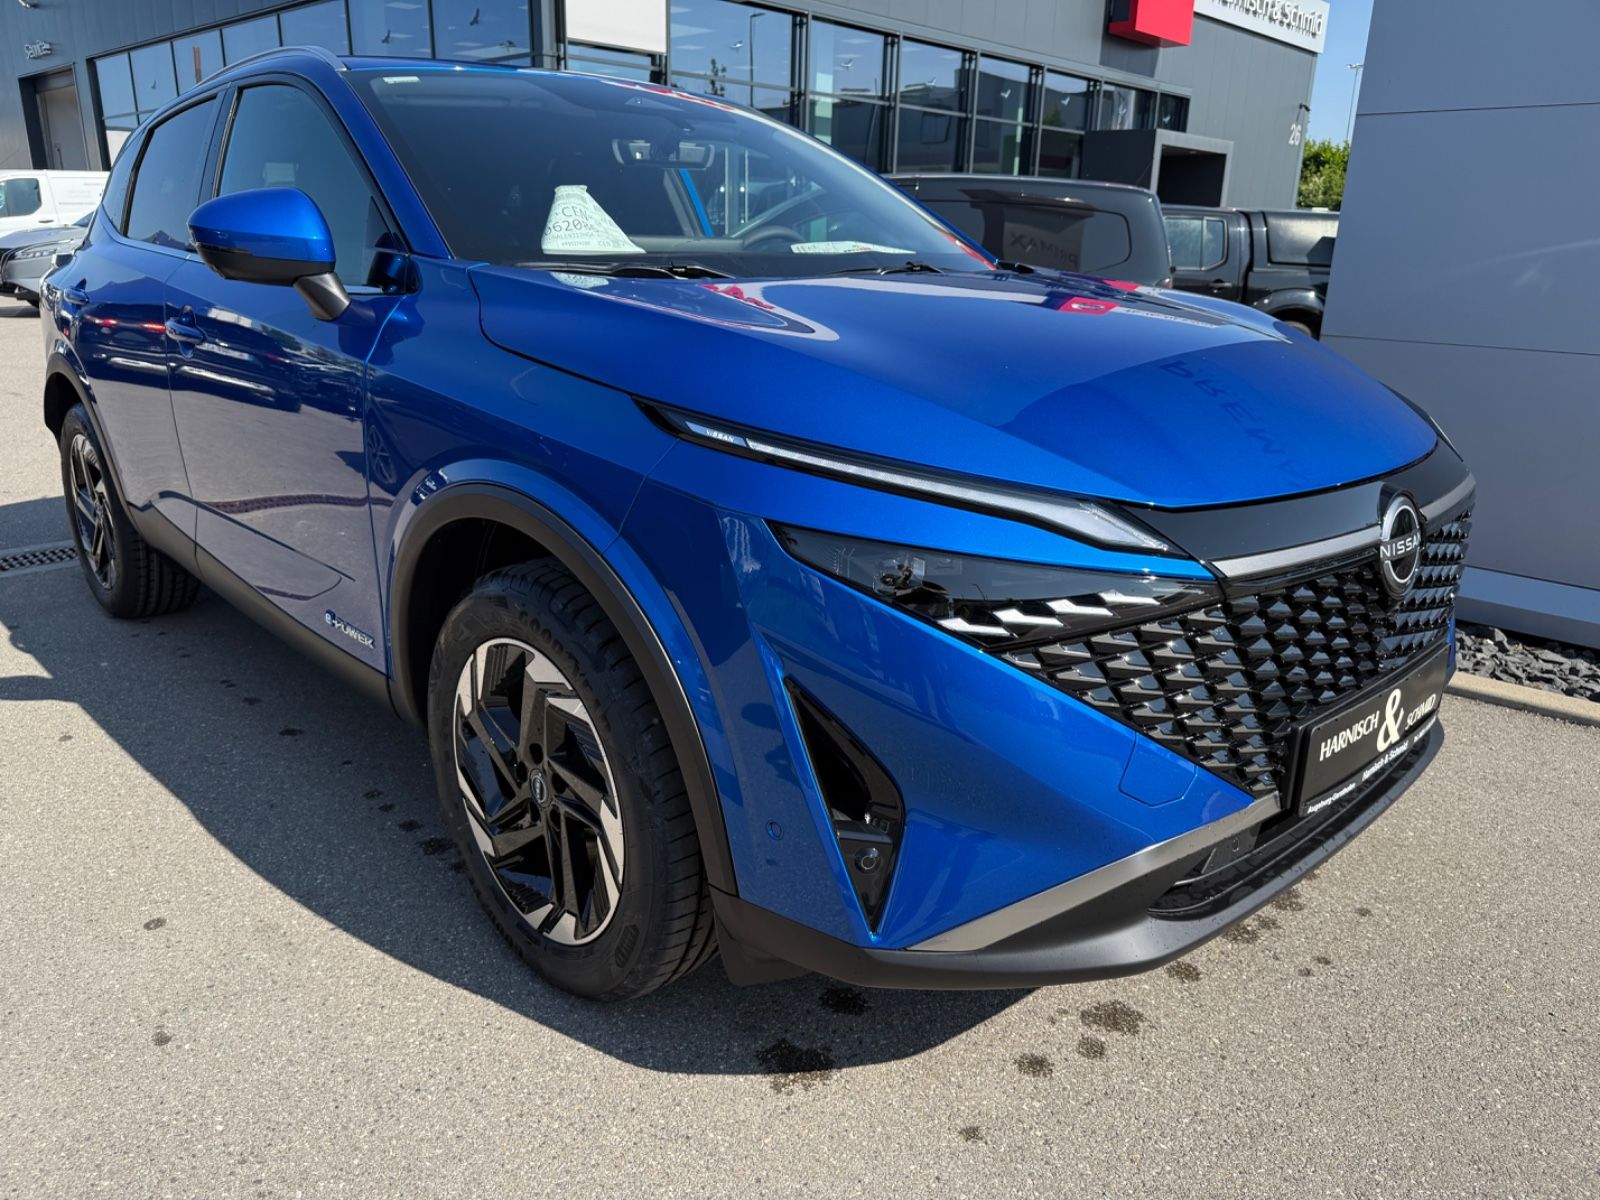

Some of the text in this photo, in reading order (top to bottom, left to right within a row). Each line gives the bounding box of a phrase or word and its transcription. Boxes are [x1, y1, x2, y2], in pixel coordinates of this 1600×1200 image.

[1289, 124, 1301, 146] 26
[1319, 710, 1380, 762] HARNISCH
[1376, 688, 1405, 752] &
[1405, 693, 1437, 730] SCHMID
